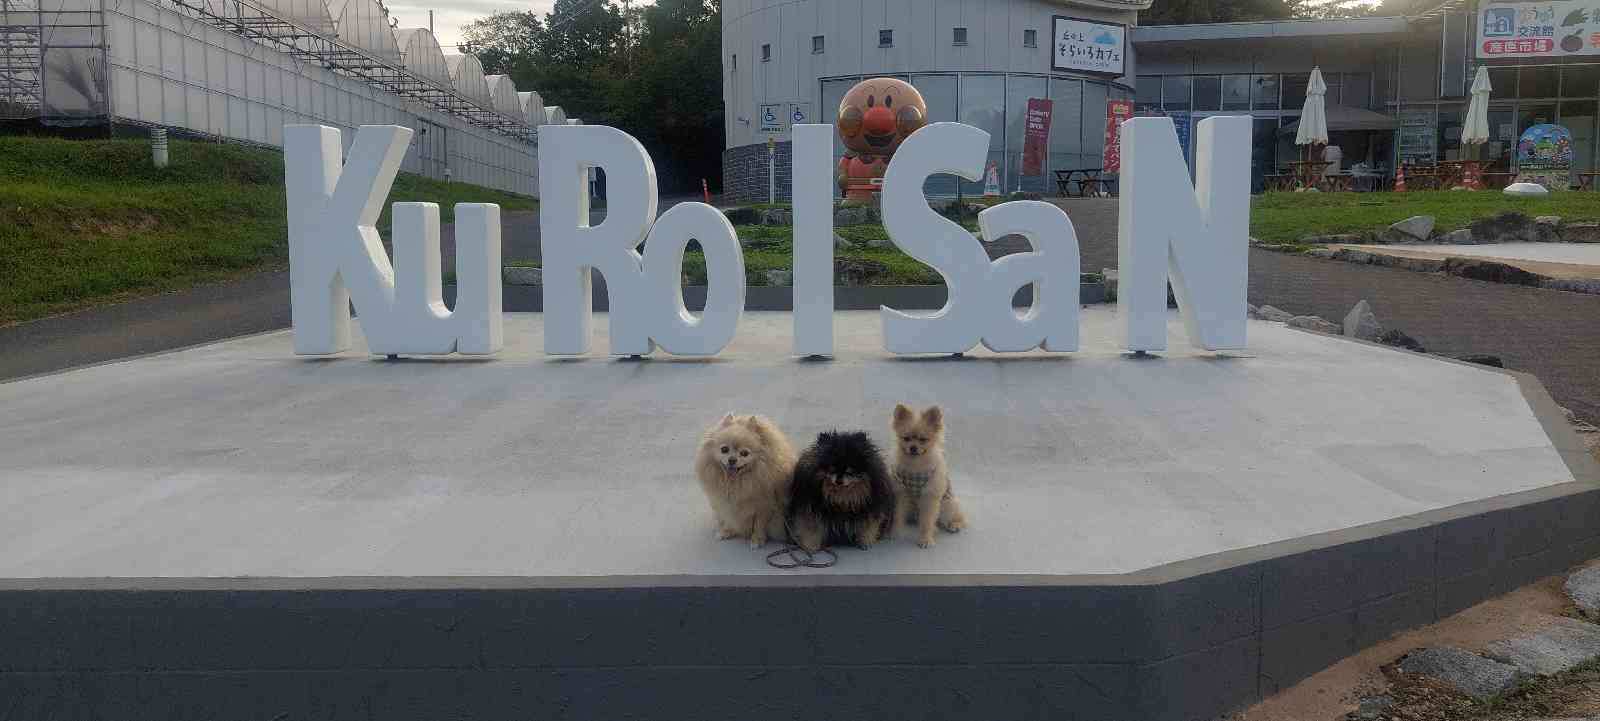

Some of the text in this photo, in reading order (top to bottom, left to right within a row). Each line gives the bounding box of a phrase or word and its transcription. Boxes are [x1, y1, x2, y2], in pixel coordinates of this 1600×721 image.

[1063, 31, 1084, 42] 丘の上
[1519, 25, 1553, 37] 交流館
[1059, 44, 1120, 63] そらいろカフェ
[1487, 40, 1547, 54] 産直市場
